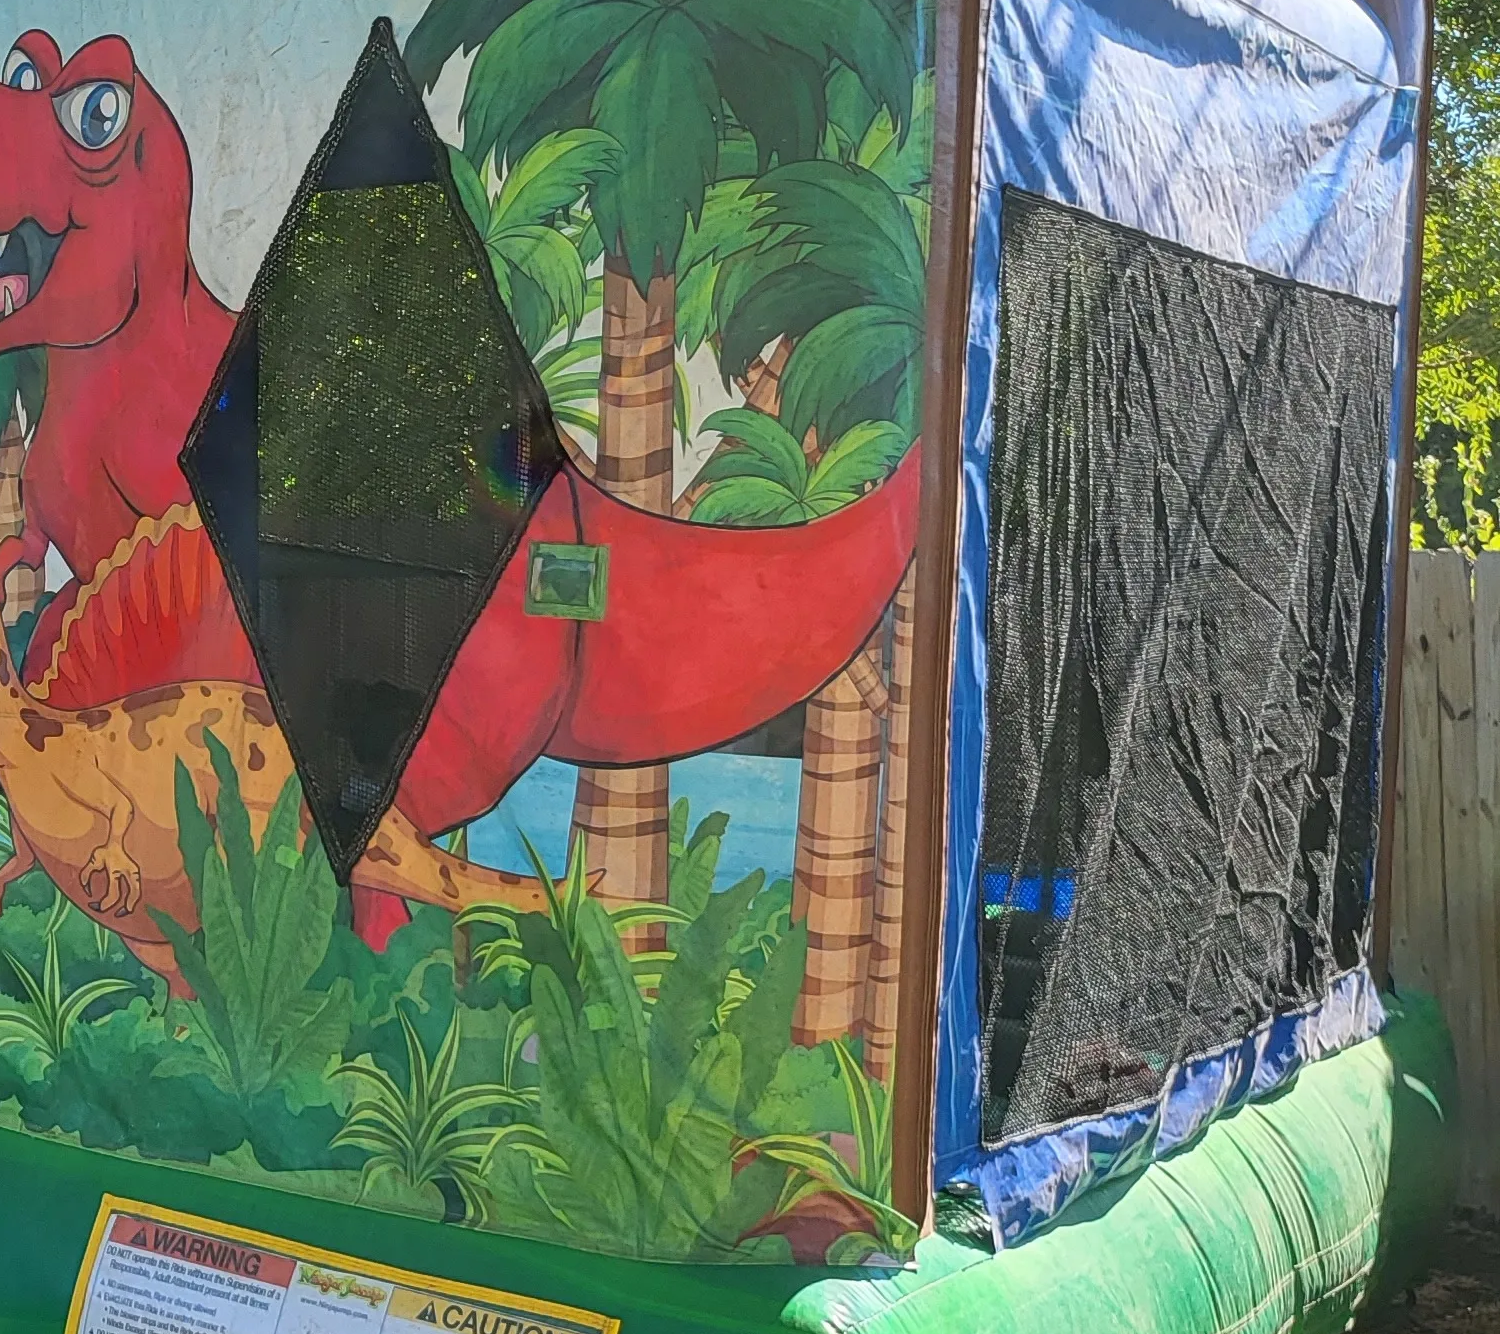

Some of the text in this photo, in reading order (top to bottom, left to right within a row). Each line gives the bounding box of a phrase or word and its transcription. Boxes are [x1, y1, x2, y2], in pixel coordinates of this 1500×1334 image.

[105, 1245, 280, 1300] DO NOT operate this Ride without the Supervision of a
[154, 1227, 262, 1277] WARNING
[203, 1285, 230, 1301] present
[230, 1292, 239, 1302] at
